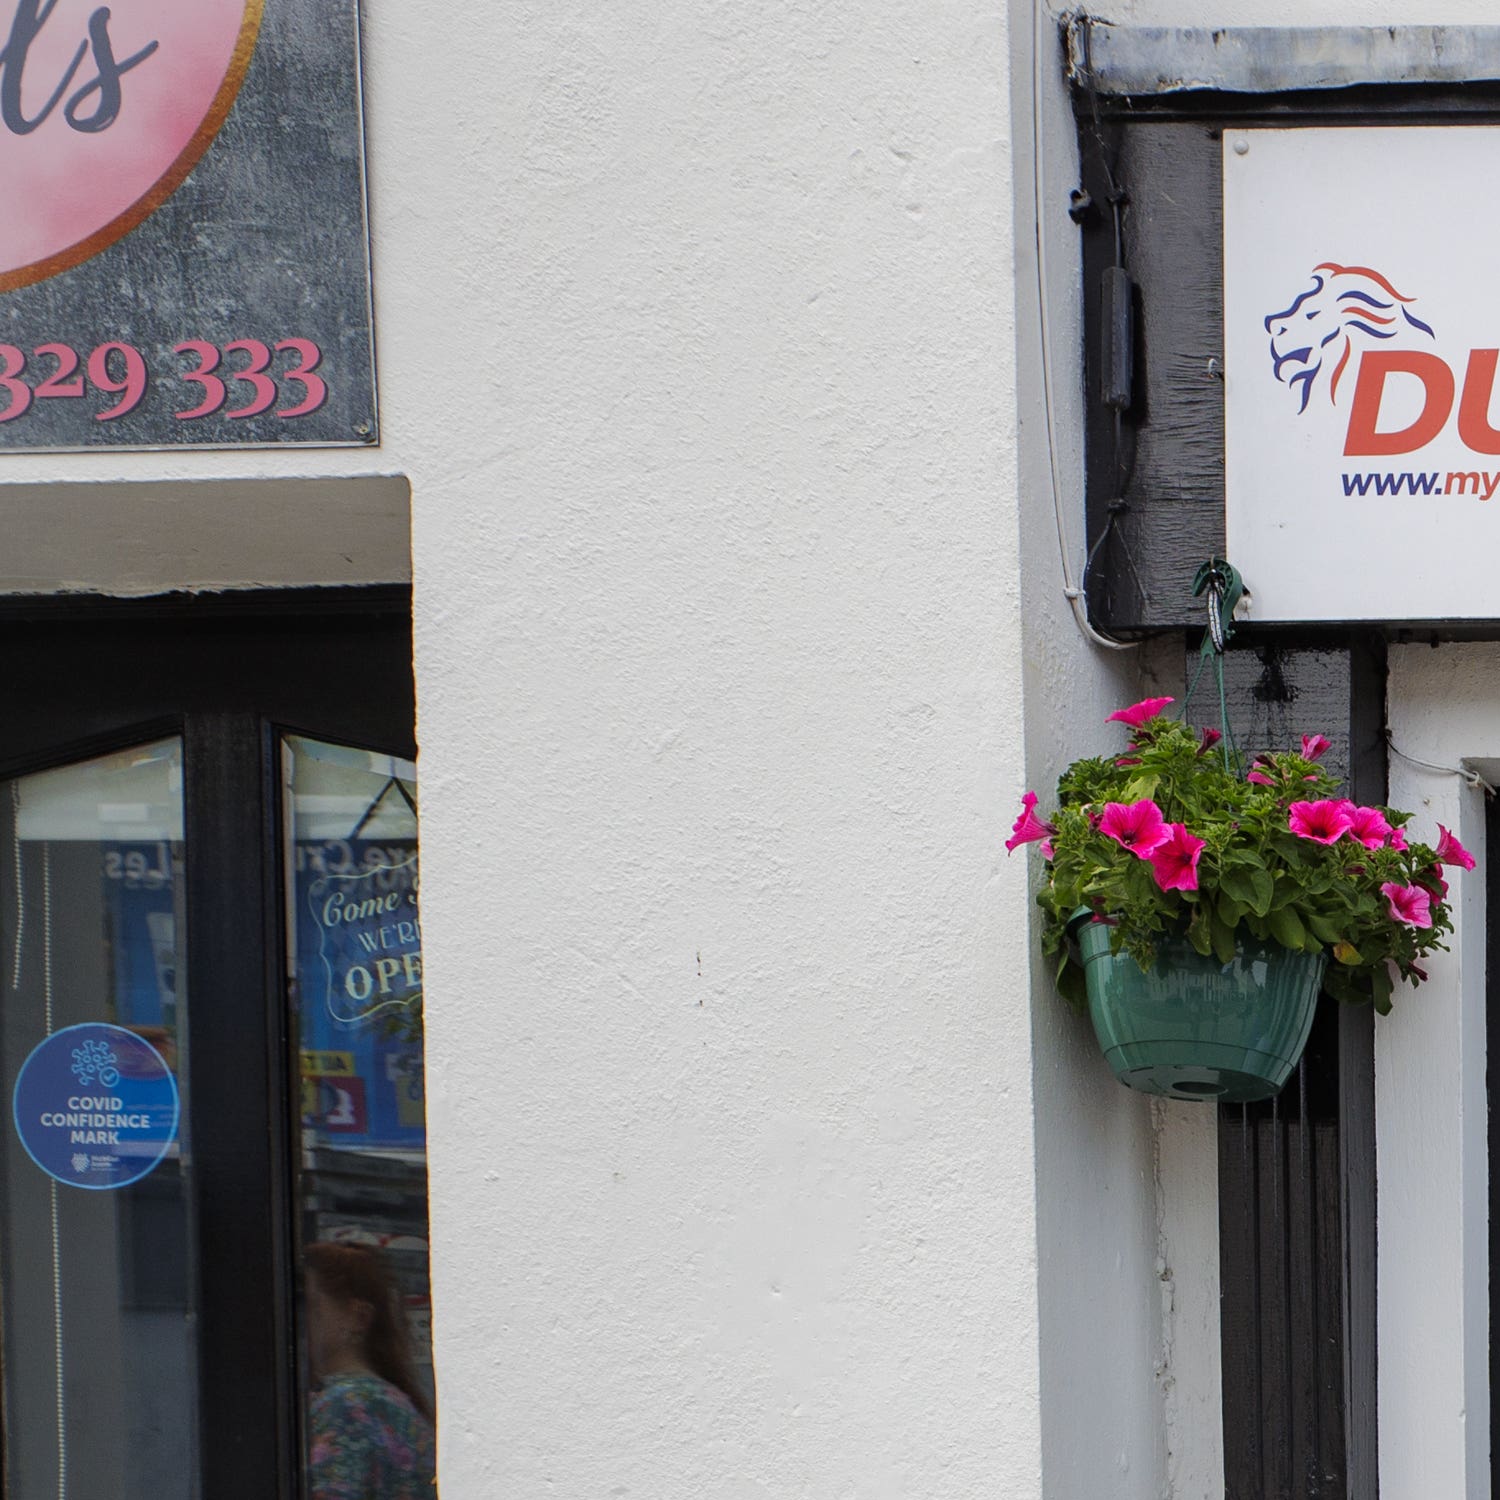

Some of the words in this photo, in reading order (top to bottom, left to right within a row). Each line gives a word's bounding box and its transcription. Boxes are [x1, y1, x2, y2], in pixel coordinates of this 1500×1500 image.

[0, 0, 159, 135] ls
[0, 342, 148, 422] 329
[174, 338, 327, 419] 333
[323, 891, 399, 928] Come
[358, 918, 420, 953] WE'R
[345, 952, 421, 1001] OPE
[41, 1112, 151, 1129] CONFIDENCE
[68, 1096, 123, 1112] COVID
[71, 1130, 119, 1146] MARK
